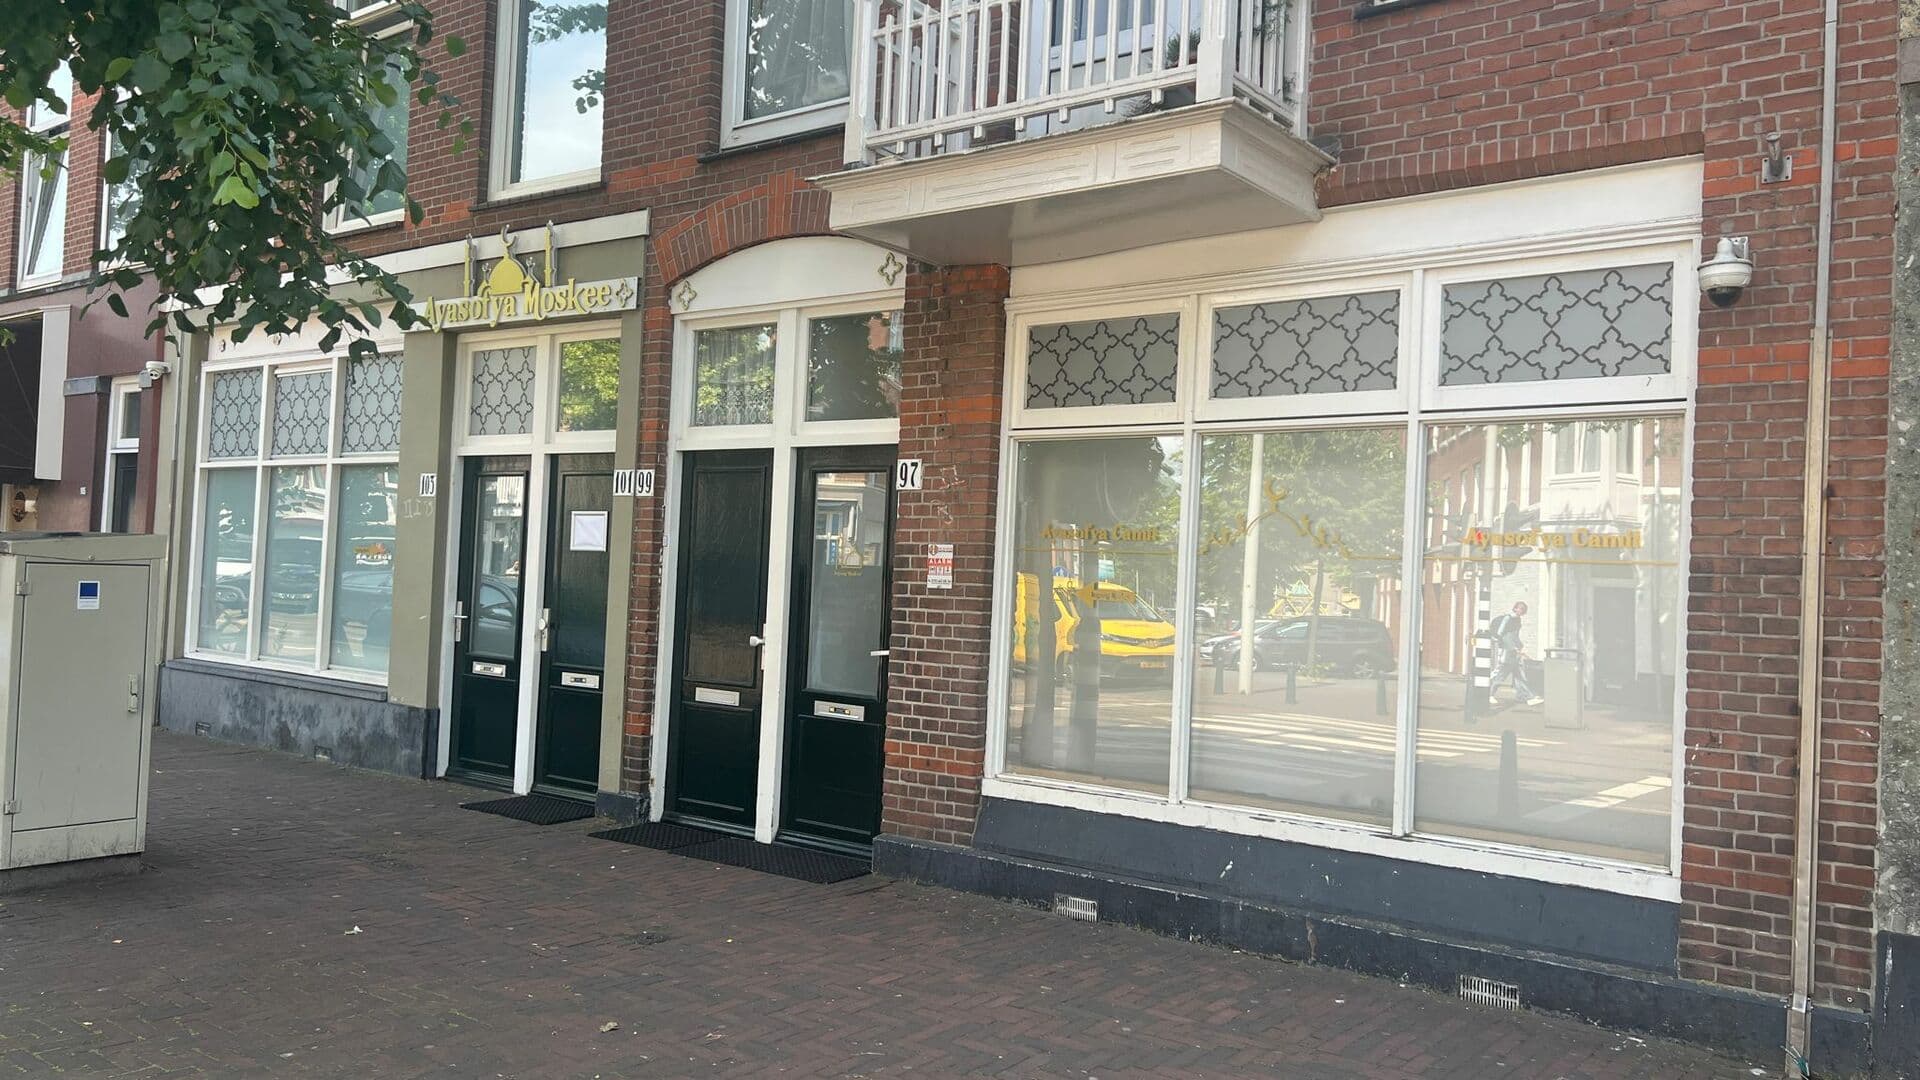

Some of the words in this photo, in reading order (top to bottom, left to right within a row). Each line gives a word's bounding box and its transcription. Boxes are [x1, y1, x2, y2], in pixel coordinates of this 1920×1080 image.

[424, 286, 517, 333] Ayasofya
[523, 278, 611, 320] Moskee
[615, 471, 633, 494] 101
[638, 471, 652, 494] 99
[899, 462, 918, 488] 97
